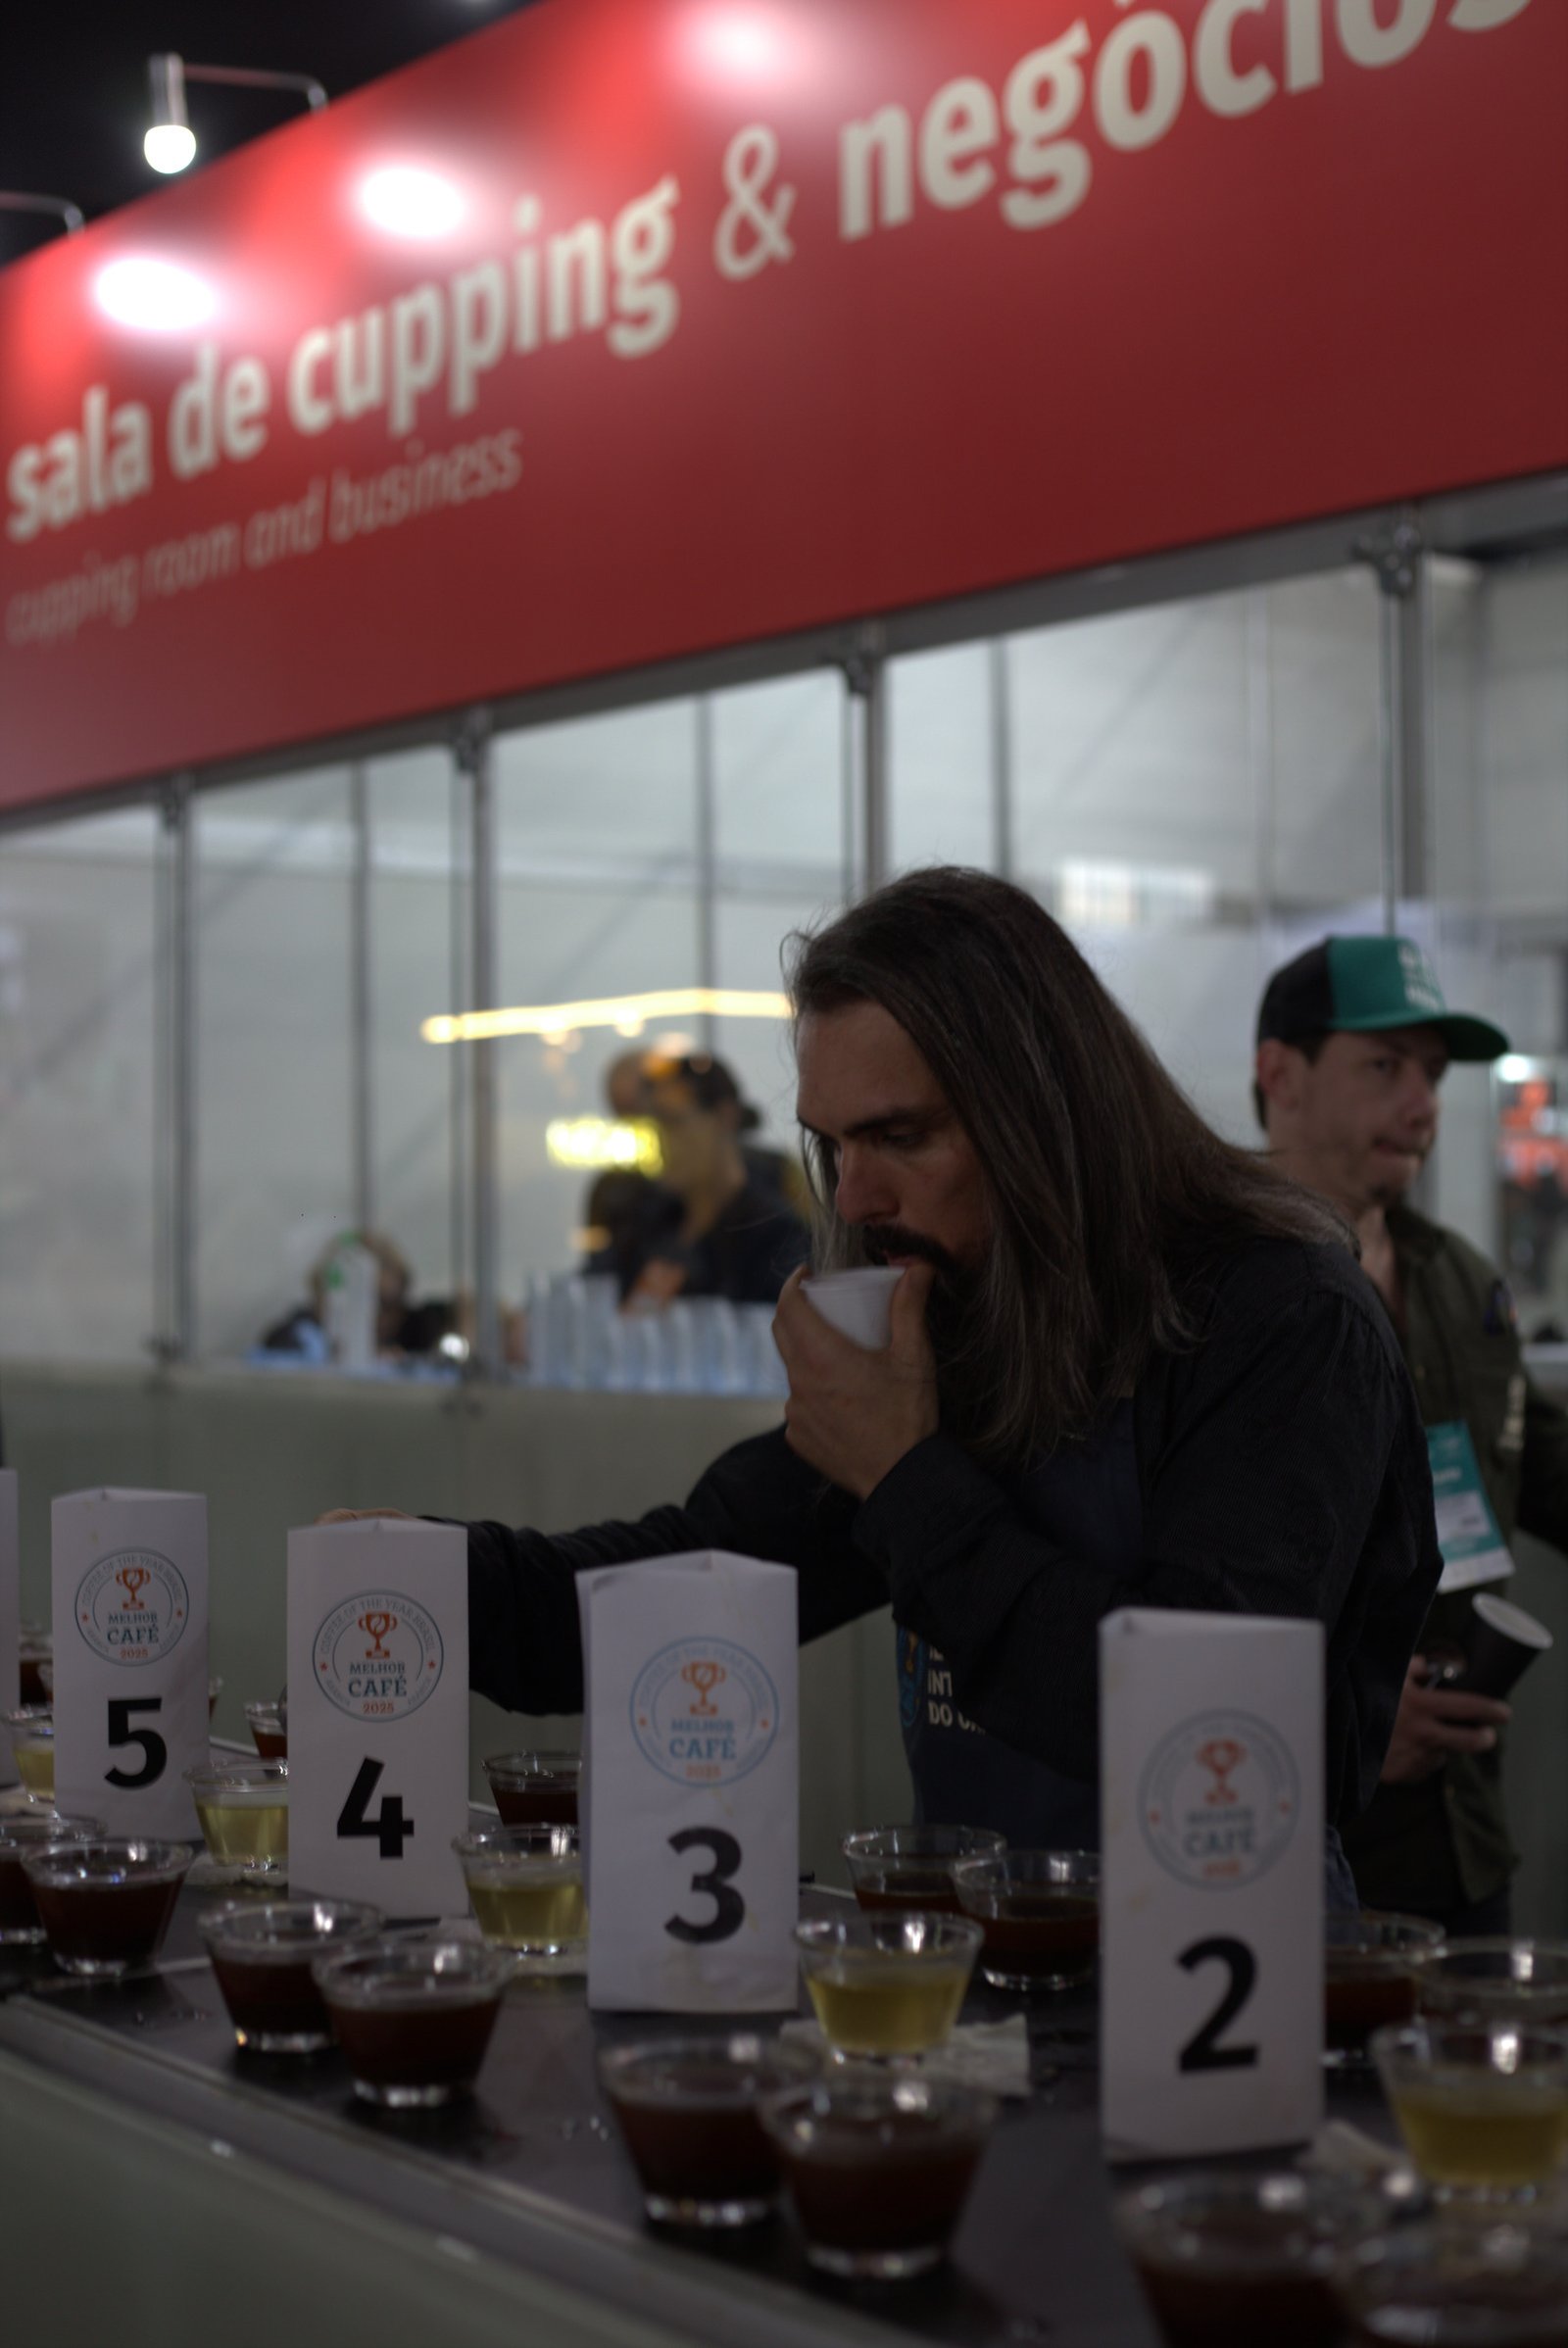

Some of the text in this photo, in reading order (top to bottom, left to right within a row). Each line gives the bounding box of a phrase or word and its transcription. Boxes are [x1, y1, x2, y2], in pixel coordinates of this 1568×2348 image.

[7, 0, 1531, 543] sala de cupping & negóc
[6, 428, 523, 648] cupping room and business
[107, 1624, 159, 1645] CAFÉ
[120, 1647, 149, 1659] 2025
[349, 1661, 406, 1675] MELHOR
[348, 1675, 407, 1697] CAFÉ
[363, 1702, 395, 1715] 2025
[927, 1699, 954, 1728] DO
[104, 1696, 168, 1789] 5
[668, 1733, 737, 1760] CAFÉ
[336, 1756, 415, 1859] 4
[664, 1827, 745, 1943] 3
[1176, 1936, 1258, 2072] 2
